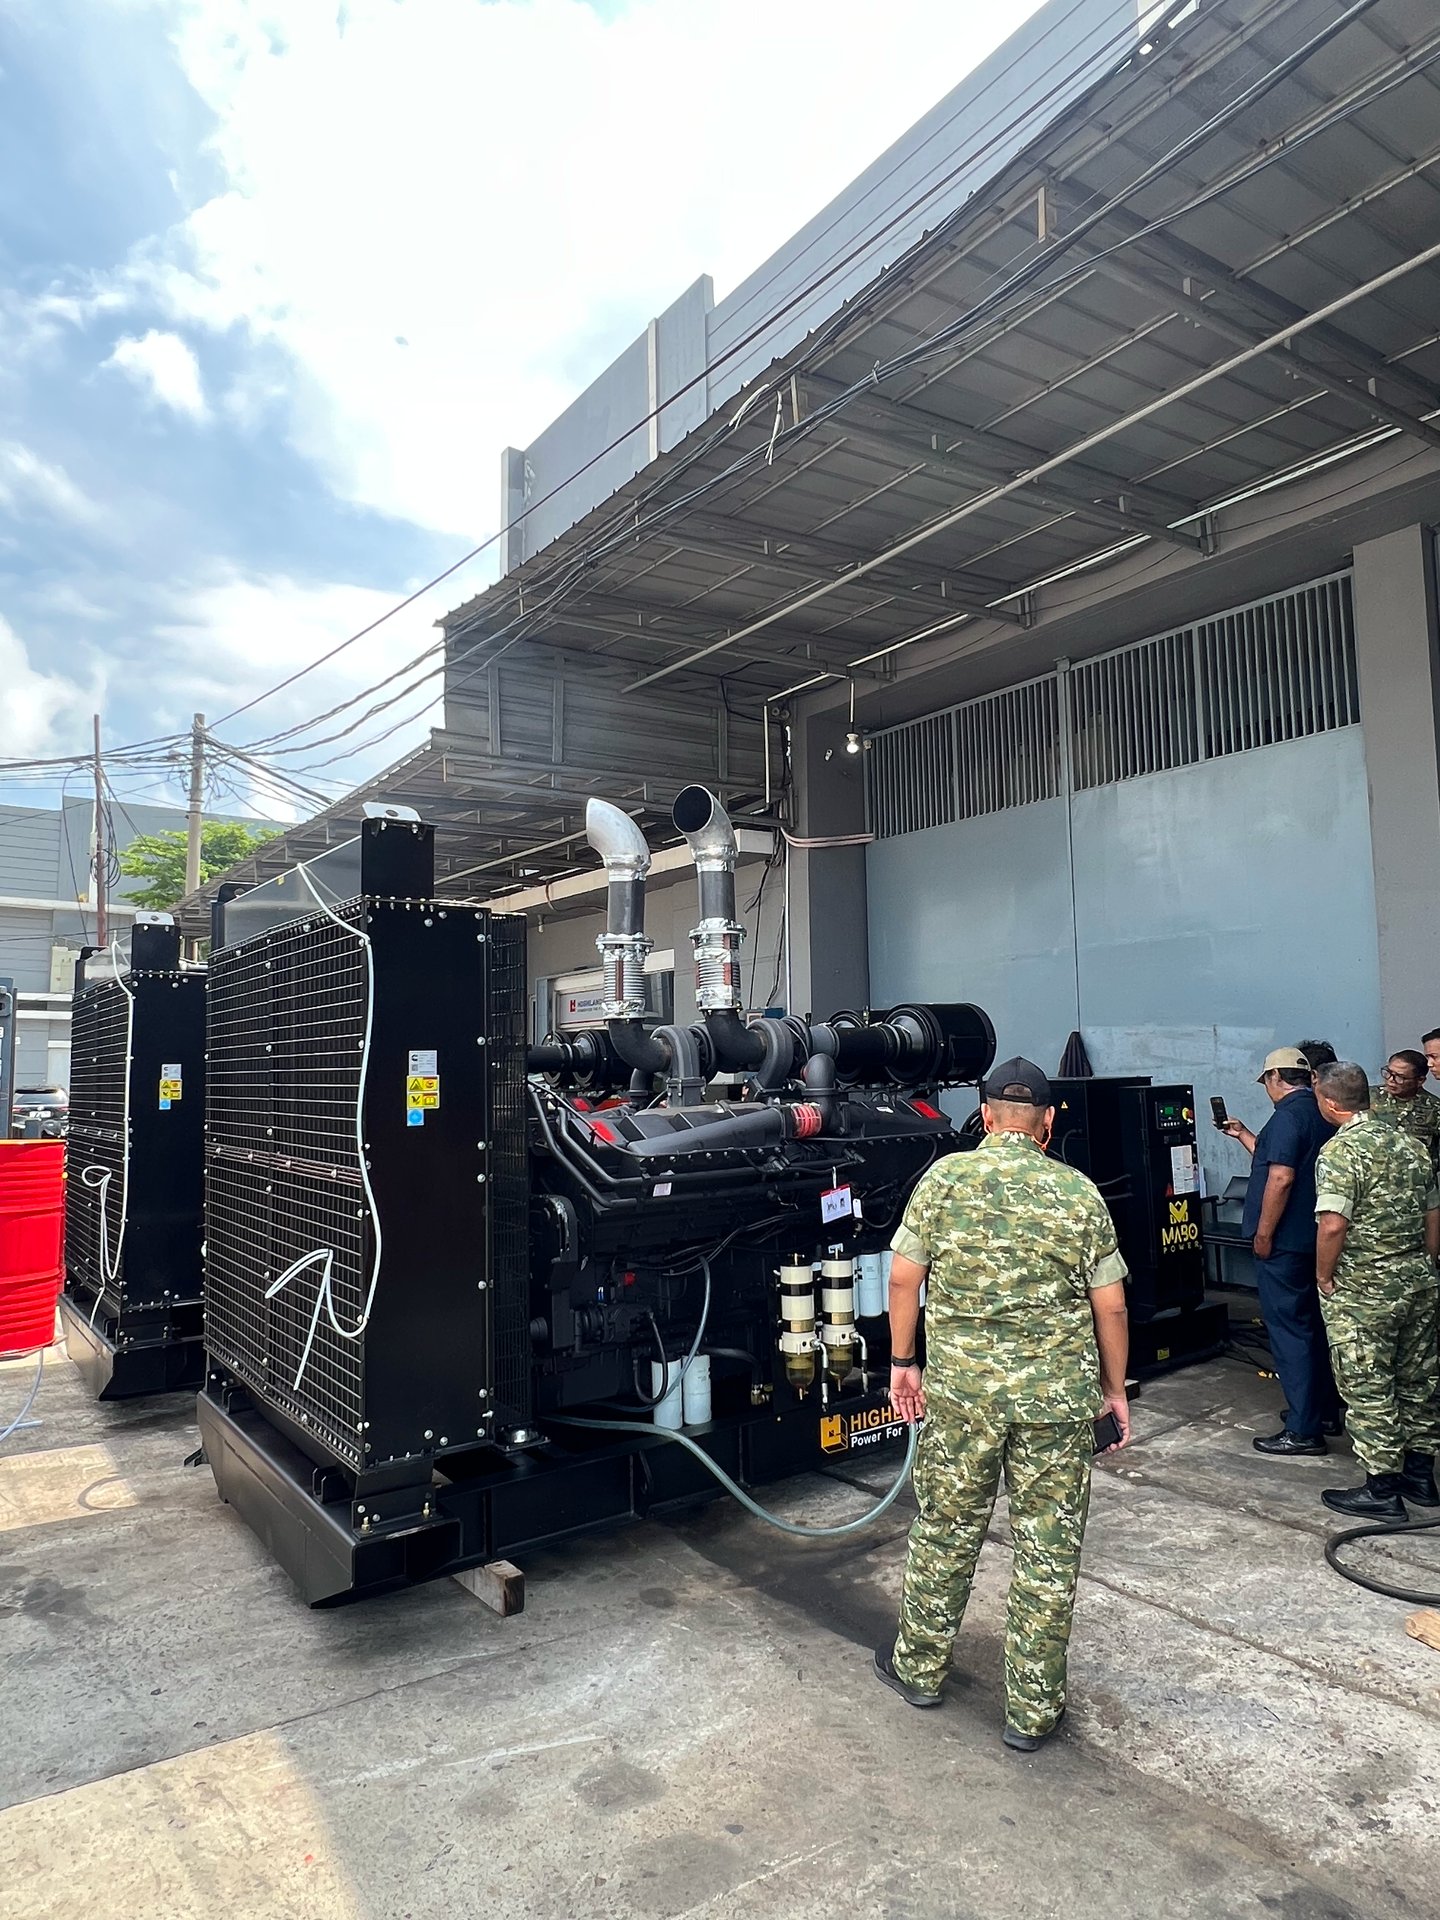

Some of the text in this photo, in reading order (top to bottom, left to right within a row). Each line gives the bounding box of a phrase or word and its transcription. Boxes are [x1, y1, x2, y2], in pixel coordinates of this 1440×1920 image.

[1162, 1223, 1198, 1246] MABO
[1163, 1240, 1200, 1254] POWER
[850, 1405, 904, 1432] HIGHL
[851, 1432, 881, 1448] Power
[886, 1427, 903, 1439] For
